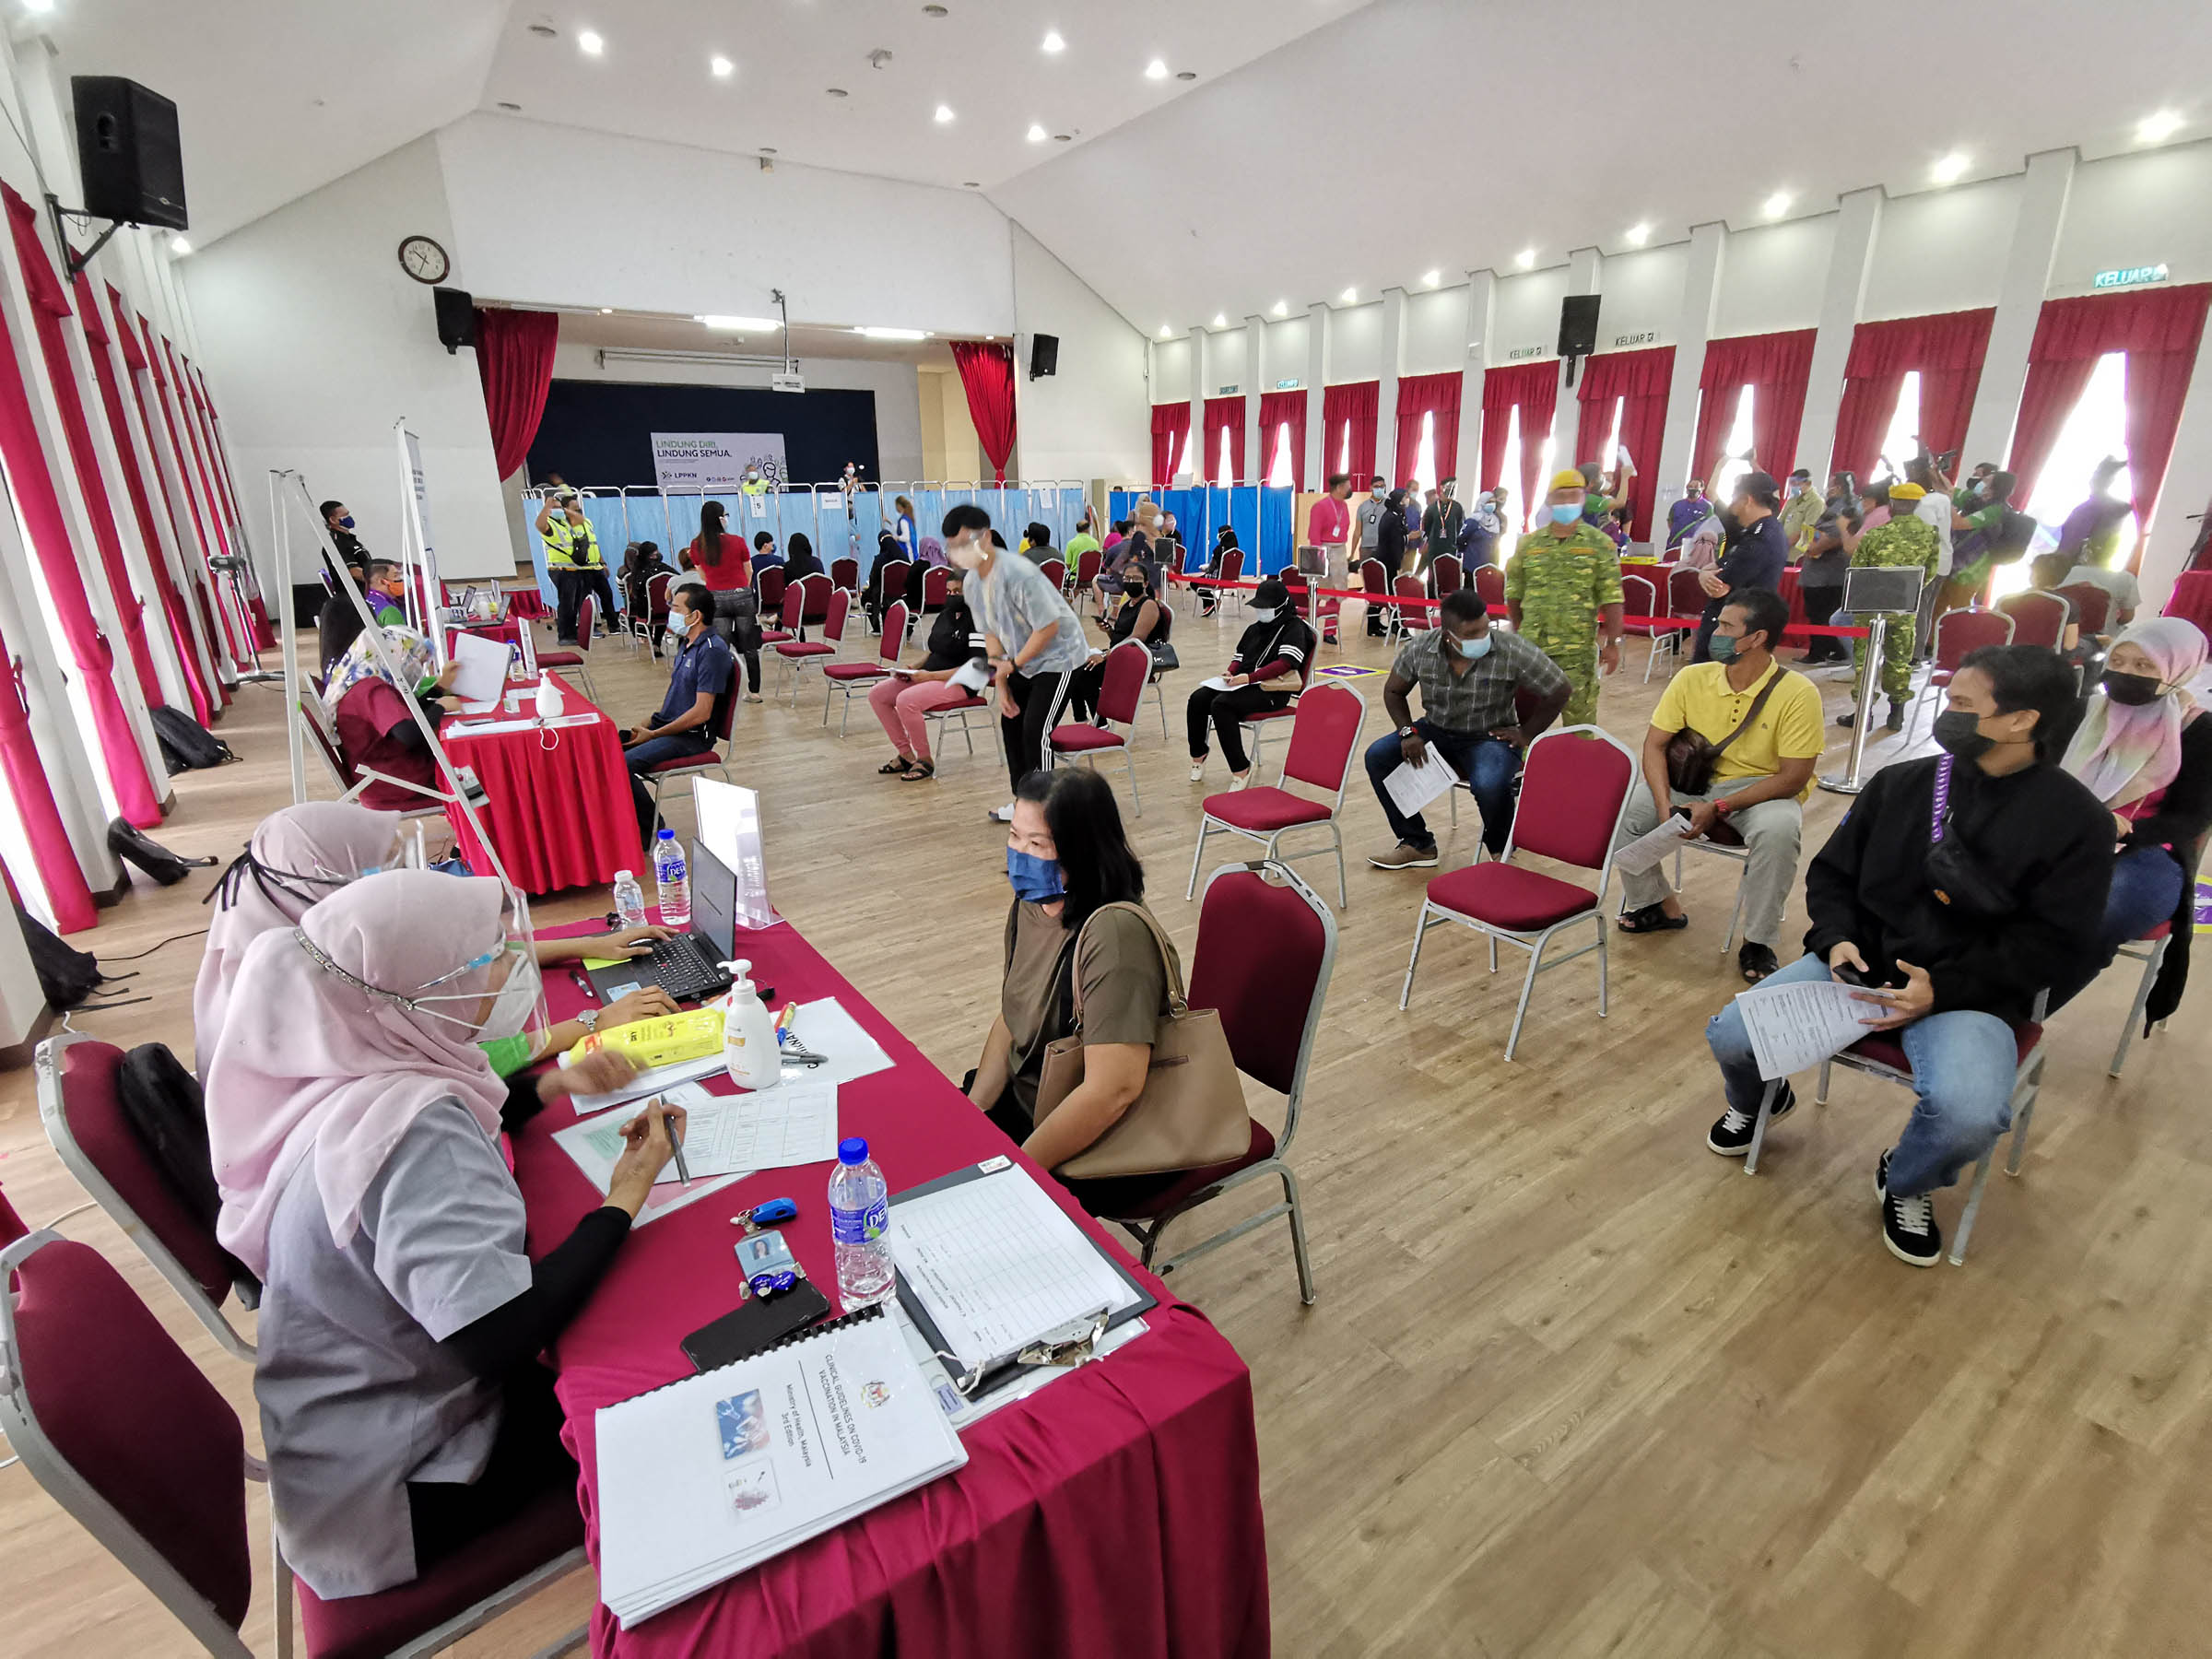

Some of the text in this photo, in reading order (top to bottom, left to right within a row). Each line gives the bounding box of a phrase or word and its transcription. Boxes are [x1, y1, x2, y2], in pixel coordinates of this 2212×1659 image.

[2094, 265, 2154, 288] KELUAR
[1615, 335, 1646, 347] KELUAR
[1510, 347, 1535, 359] KELUAR
[655, 441, 698, 449] LINDUNG
[656, 449, 699, 458] LINDUNG
[818, 1370, 851, 1455] VACCINATION IN MALAYSIA
[825, 1353, 867, 1464] CLINICAL GUIDELINES ON COVID-19
[782, 1412, 794, 1447] 3rd Edition
[786, 1383, 796, 1409] Ministry
[794, 1418, 805, 1440] Health,
[801, 1439, 812, 1467] Malaysia
